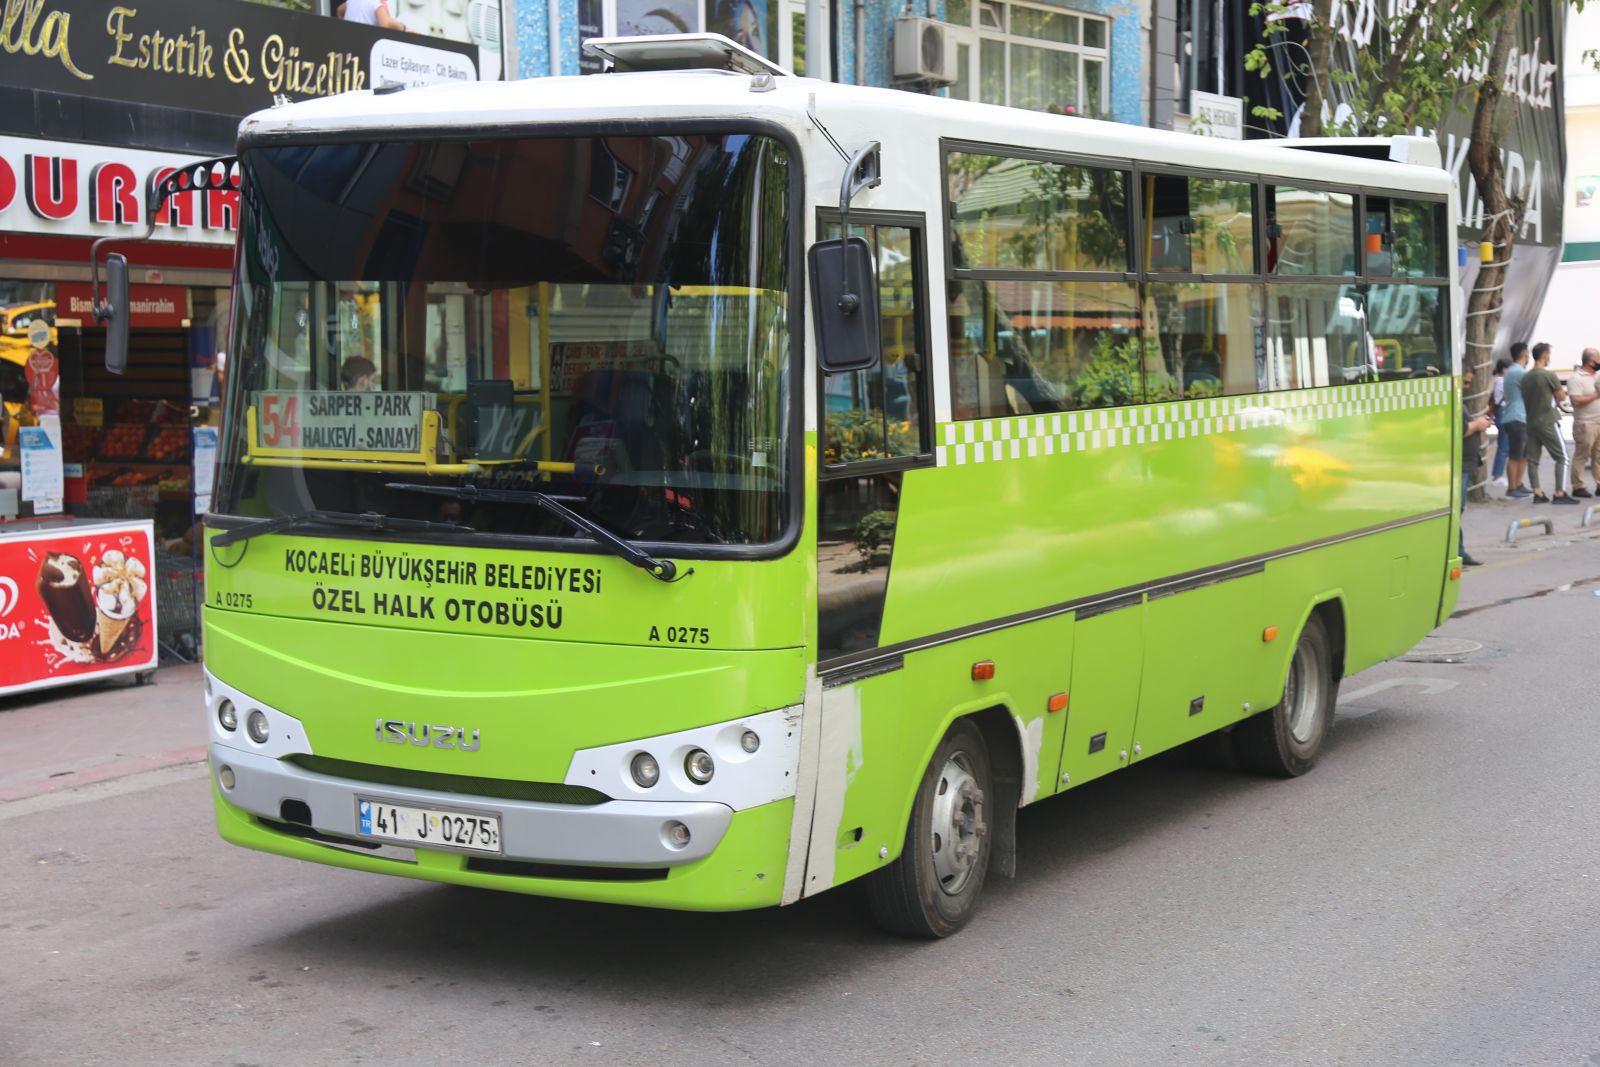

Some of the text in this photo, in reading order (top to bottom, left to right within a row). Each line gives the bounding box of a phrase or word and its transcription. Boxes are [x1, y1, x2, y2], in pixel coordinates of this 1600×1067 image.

[106, 6, 366, 96] Estetik & Güzellik
[263, 396, 300, 448] 54
[309, 394, 363, 417] SARPER
[374, 395, 412, 417] PARK
[303, 424, 356, 449] HALKEVİ
[366, 424, 419, 450] SANAYİ
[216, 591, 253, 609] A 0275
[312, 581, 563, 630] ÖZEL HALK OTOBÜSÜ
[648, 625, 710, 645] A 0275
[375, 718, 481, 753] ISUZU
[377, 806, 492, 845] 41 J 0275
